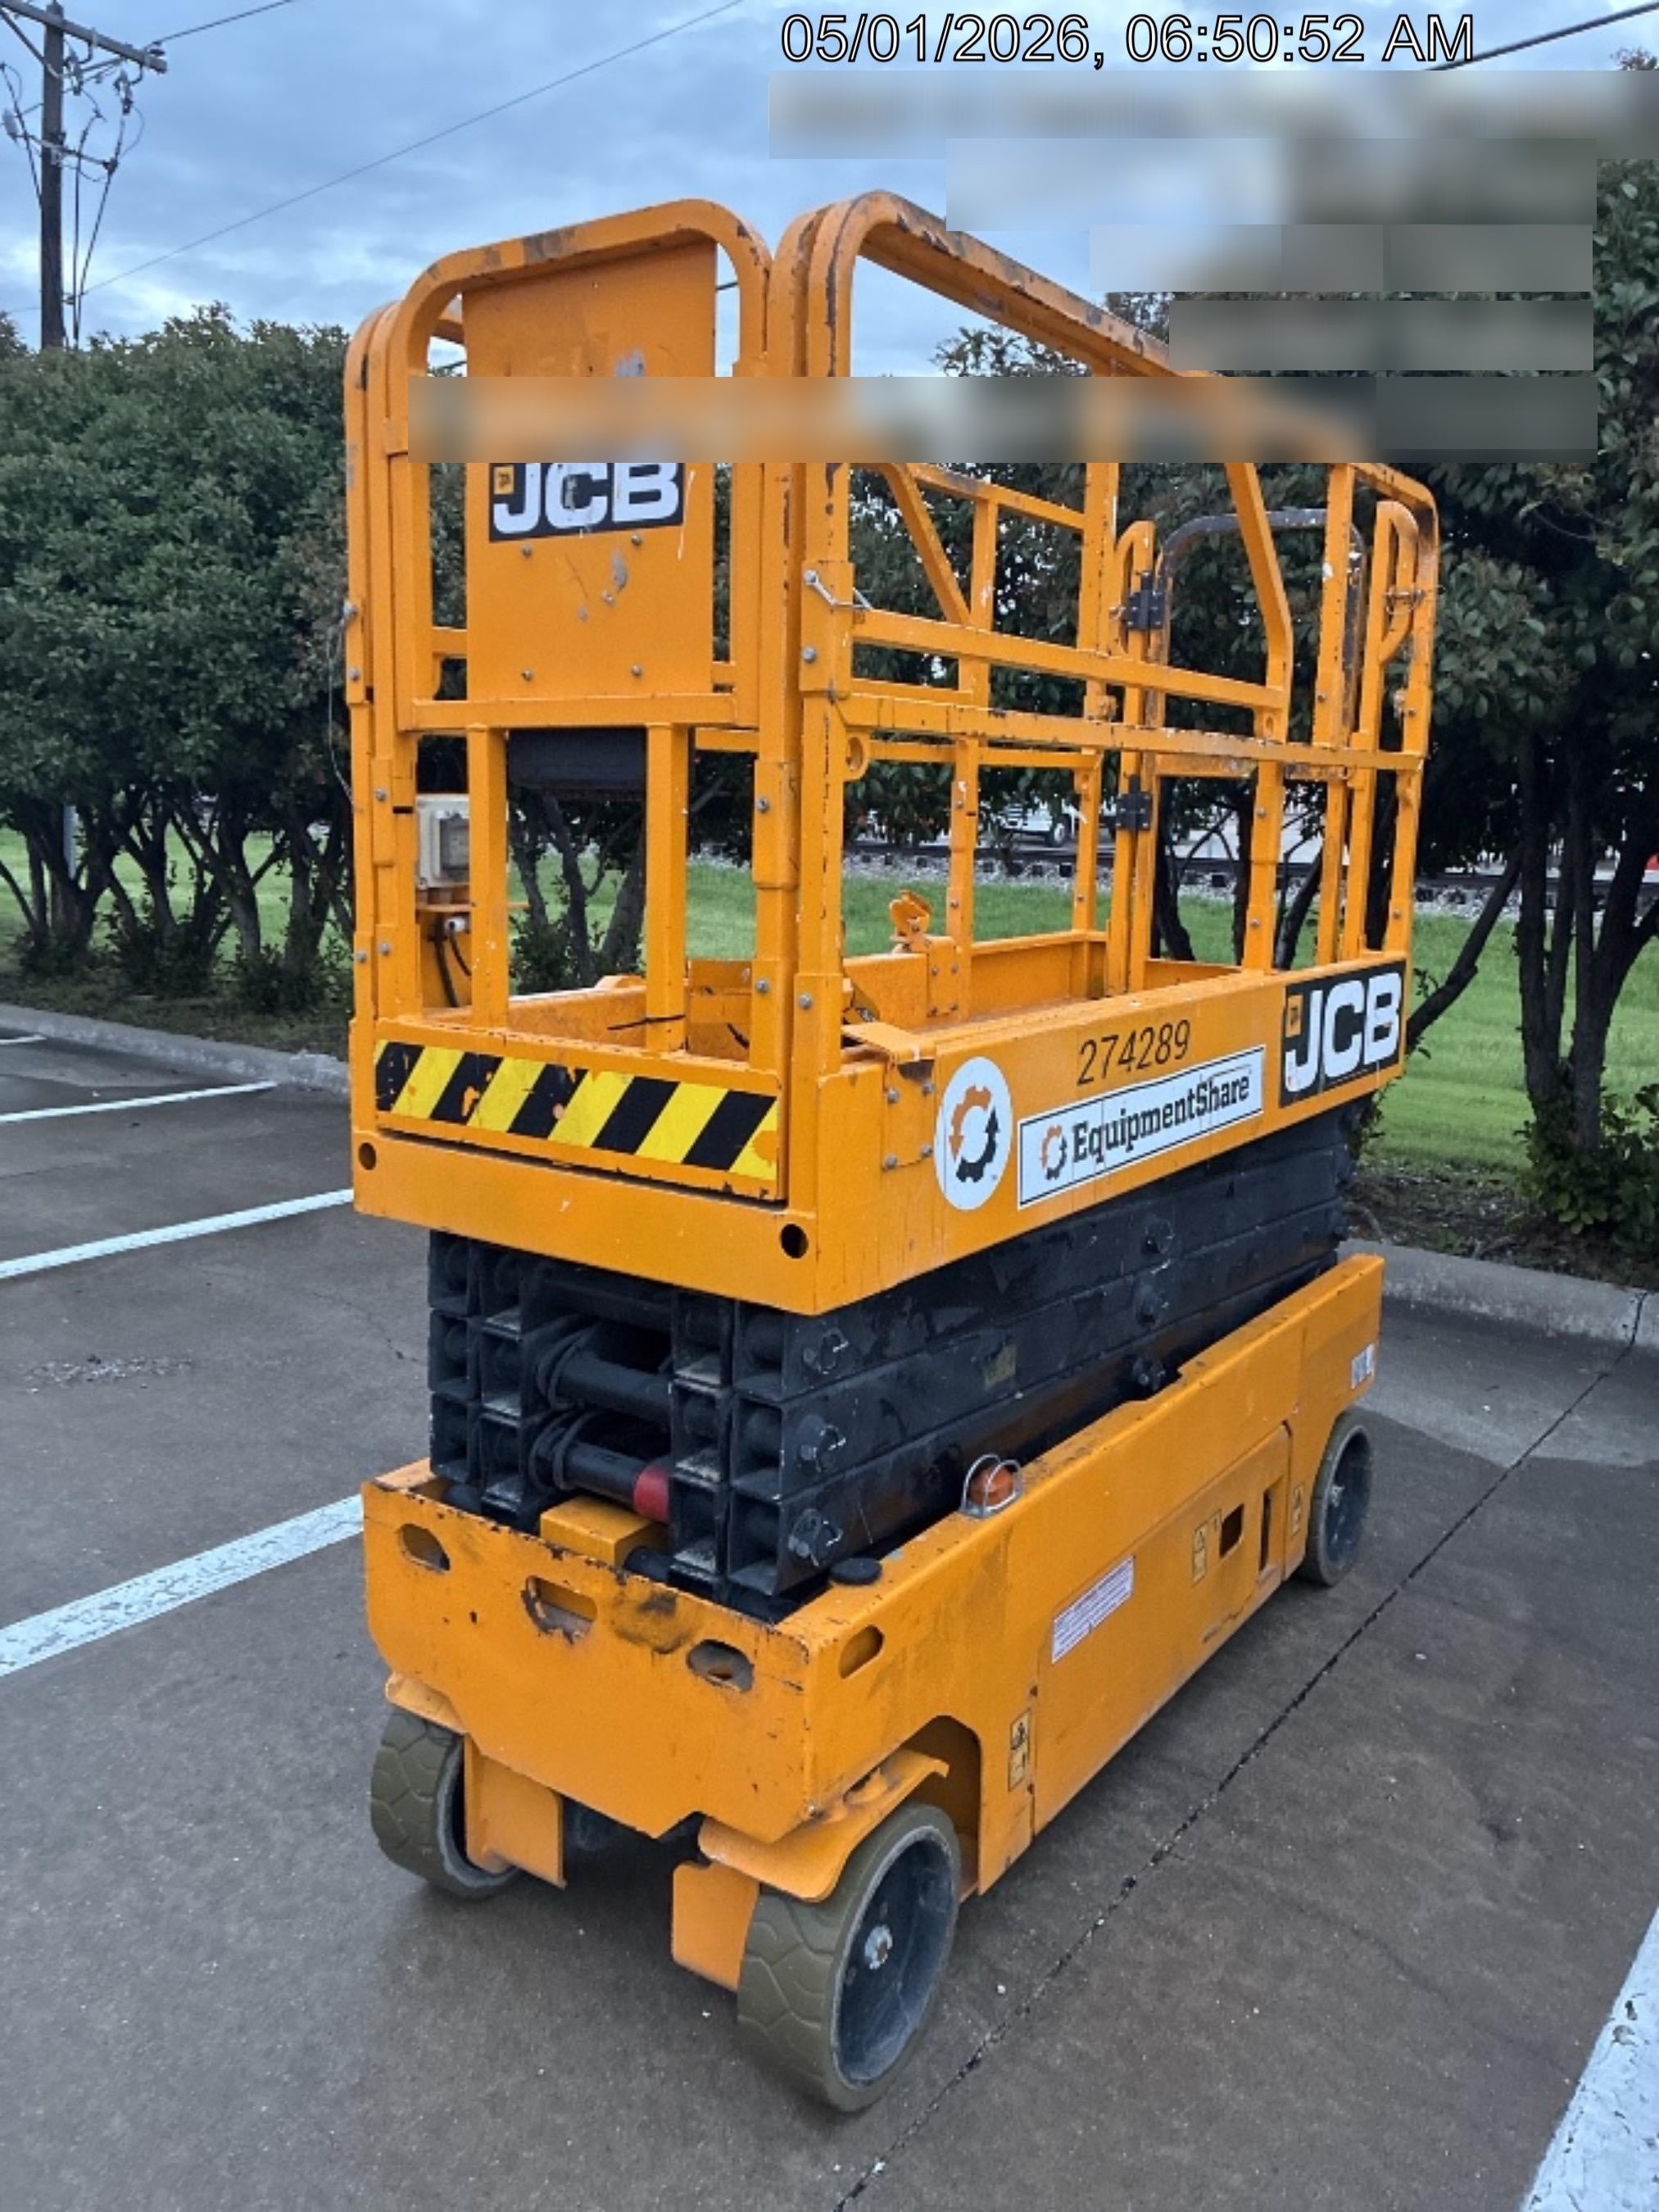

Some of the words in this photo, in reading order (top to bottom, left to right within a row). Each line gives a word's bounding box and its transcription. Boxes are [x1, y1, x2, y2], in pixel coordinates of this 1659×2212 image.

[493, 463, 679, 533] JCB
[1077, 1019, 1190, 1086] 274289
[1285, 972, 1402, 1093] JCB
[1072, 1074, 1250, 1164] EquipmentShare
